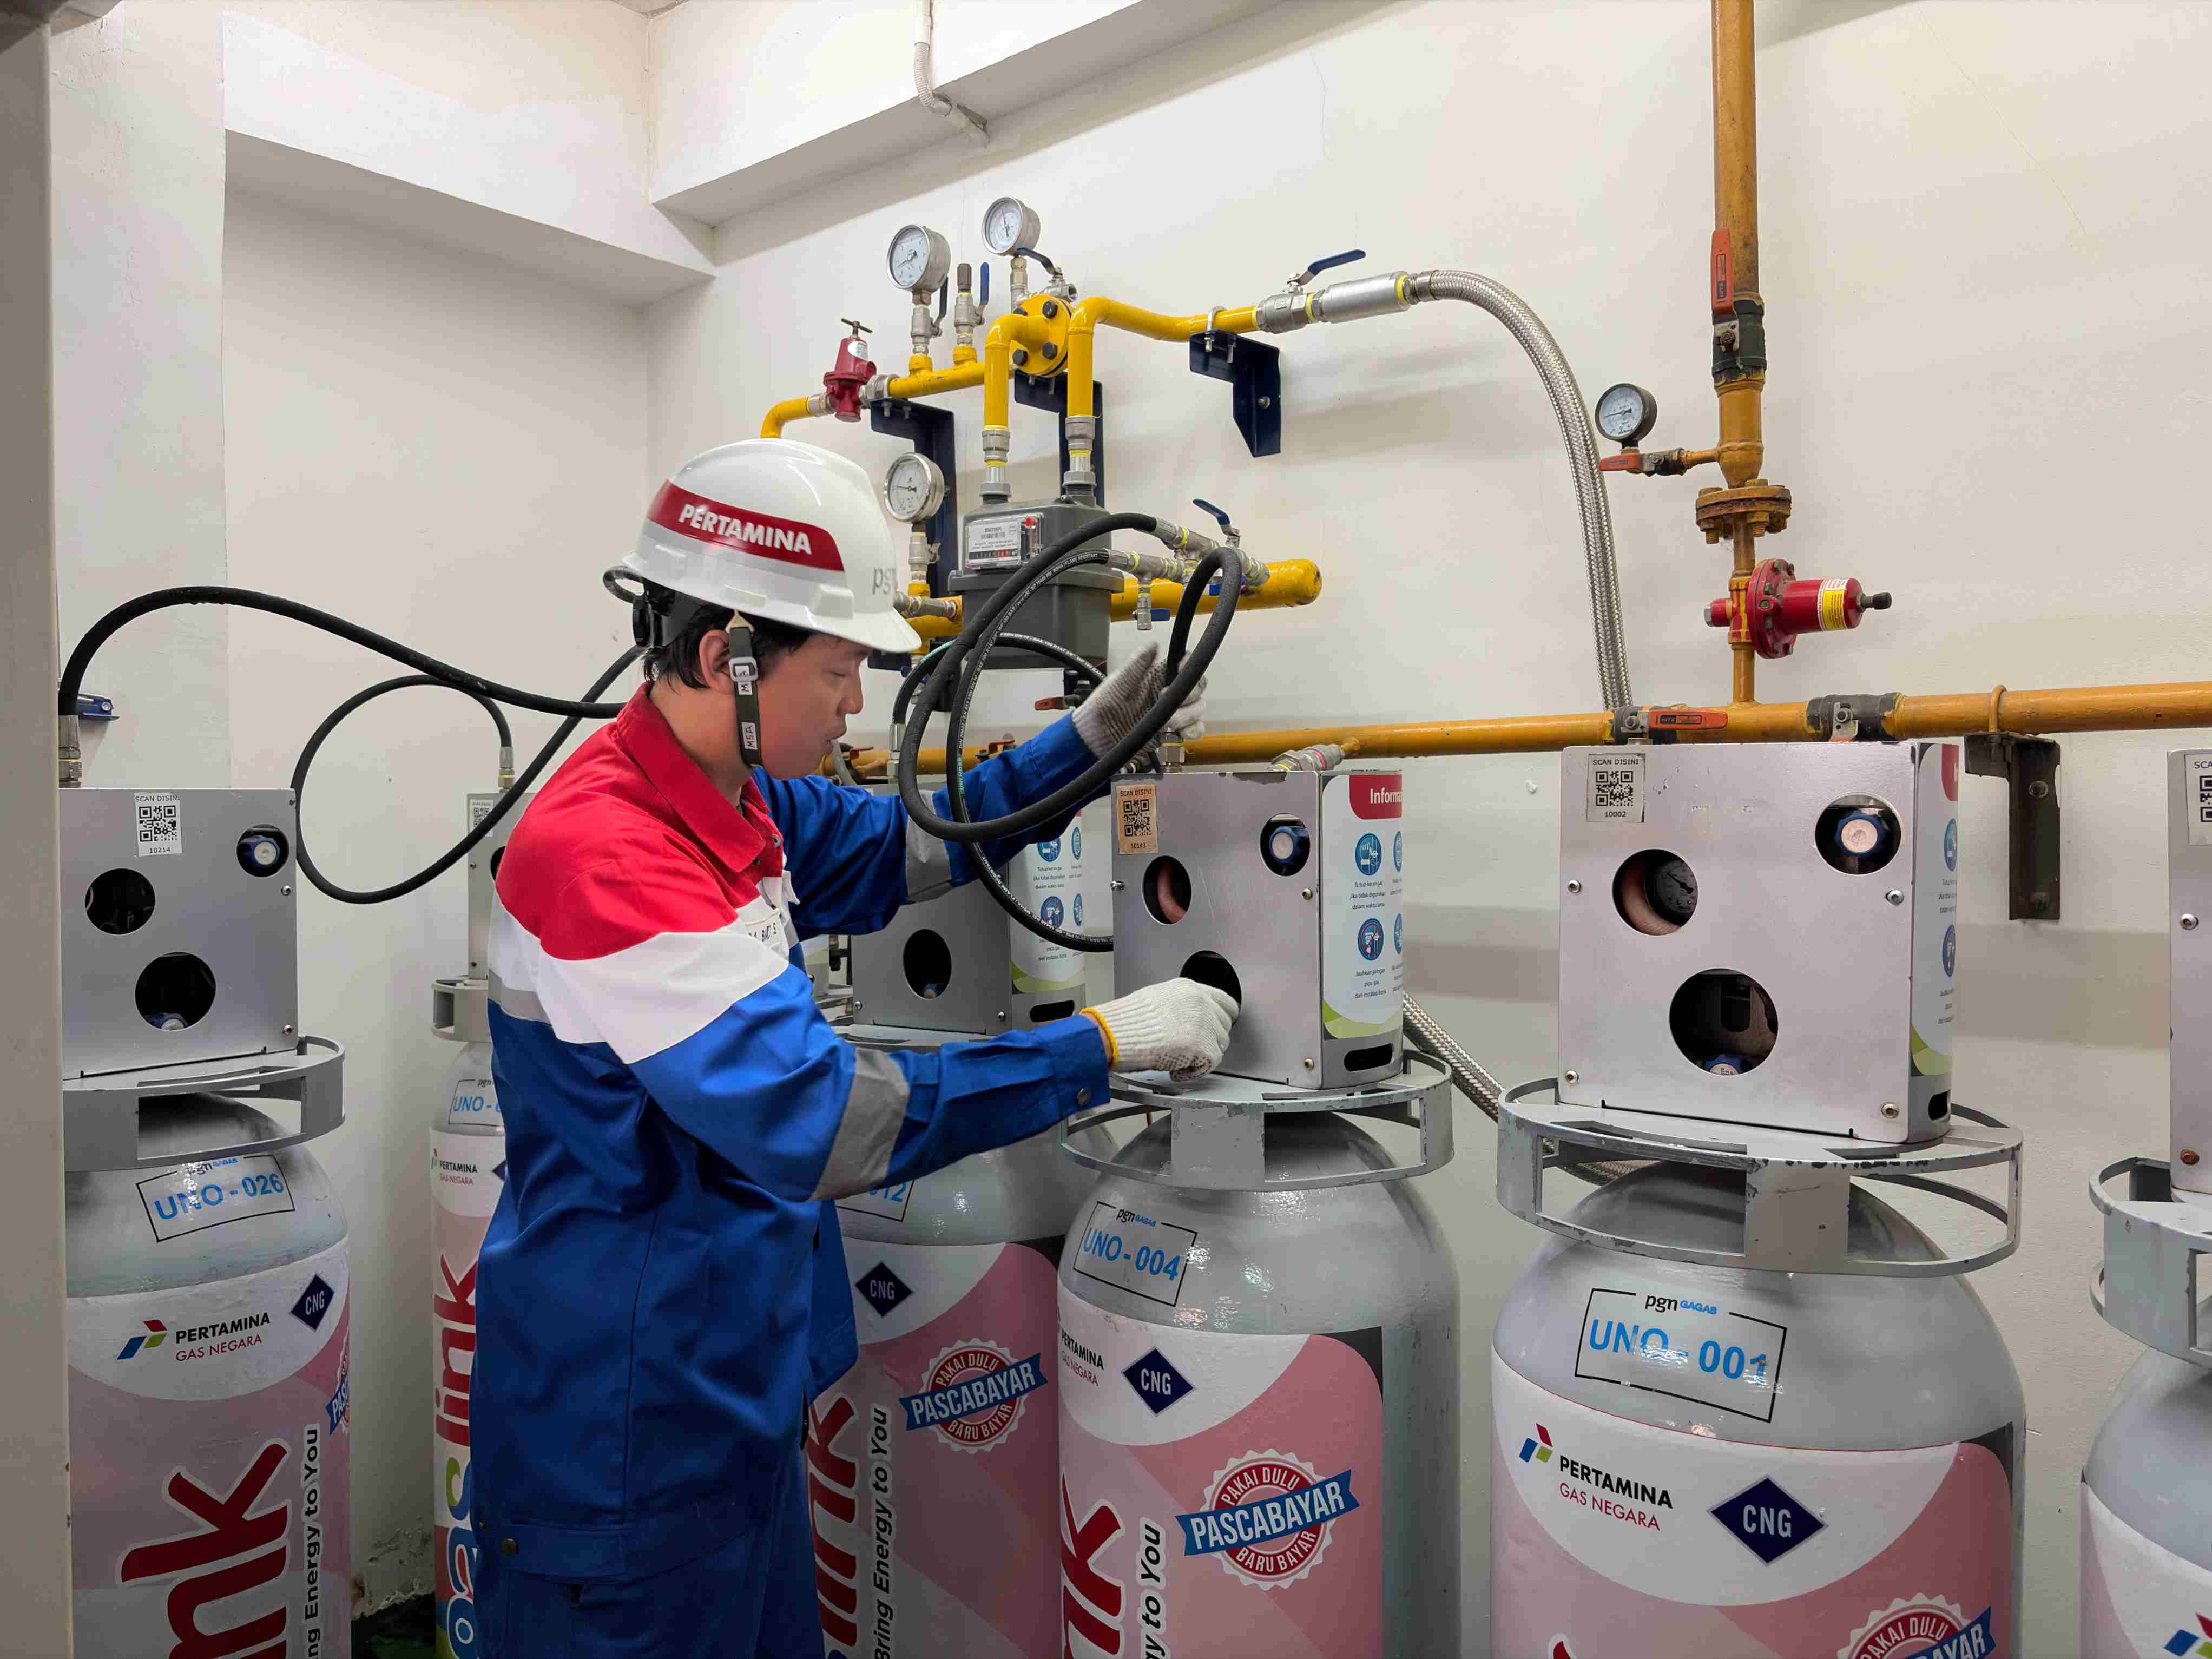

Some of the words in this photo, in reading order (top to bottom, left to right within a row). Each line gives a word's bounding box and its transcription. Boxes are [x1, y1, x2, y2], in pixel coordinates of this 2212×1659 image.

[678, 504, 812, 555] PERTAMINA
[745, 726, 755, 748] MSA
[439, 1160, 478, 1174] PERTAMINA
[449, 1175, 473, 1186] NEGARA
[1116, 1209, 1135, 1223] pgn
[305, 1290, 325, 1316] CNG
[870, 1279, 895, 1300] CNG
[1644, 1294, 1677, 1313] pgn
[175, 1312, 271, 1344] PERTAMINA
[175, 1346, 205, 1362] GAS
[209, 1333, 262, 1357] NEGARA
[1061, 1328, 1104, 1371] PERTAMINA
[935, 1356, 966, 1387] PAKAI
[969, 1353, 999, 1372] DULU
[1070, 1361, 1099, 1387] NEGARA
[1140, 1368, 1171, 1395] CNG
[911, 1362, 1036, 1425] PASCABAYAR
[871, 1408, 888, 1456] You
[947, 1419, 979, 1440] BARU
[981, 1404, 1013, 1437] BAYAR
[304, 1428, 318, 1481] You
[872, 1466, 888, 1493] to
[1220, 1469, 1259, 1506] PAKAI
[1262, 1466, 1300, 1491] DULU
[1559, 1454, 1673, 1509] PERTAMINA
[305, 1488, 318, 1517] to
[1190, 1480, 1346, 1550] PASCABAYAR
[1559, 1482, 1587, 1506] GAS
[1592, 1495, 1661, 1531] NEGARA
[1742, 1504, 1792, 1538] CNG
[873, 1499, 892, 1594] Energy
[1140, 1523, 1161, 1583] You
[1235, 1546, 1274, 1573] BARU
[1276, 1530, 1317, 1571] BAYAR
[305, 1525, 320, 1620] Energy
[1141, 1595, 1161, 1629] to
[1909, 1616, 1948, 1641] DULU
